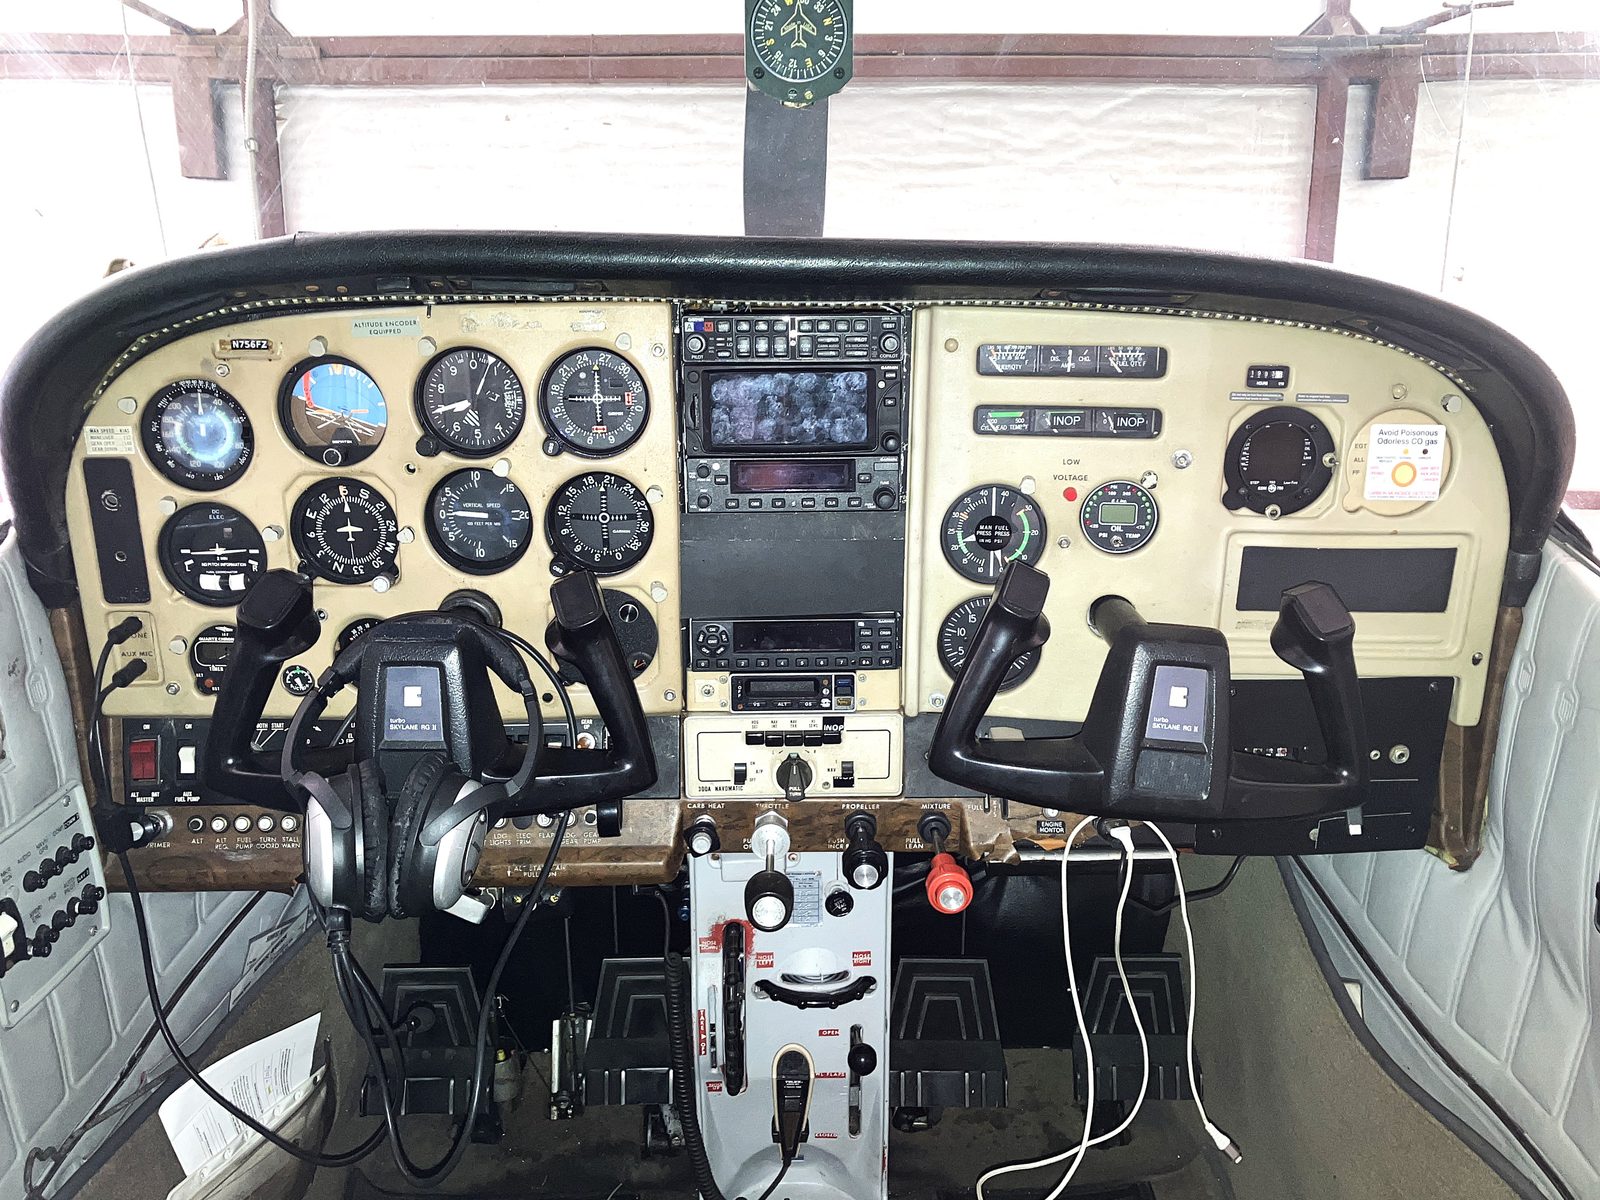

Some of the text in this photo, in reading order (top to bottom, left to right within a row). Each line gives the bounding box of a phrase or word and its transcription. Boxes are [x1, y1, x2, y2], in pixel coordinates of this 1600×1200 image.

[771, 5, 781, 16] 24
[814, 4, 824, 13] 33
[765, 20, 773, 31] 21
[823, 17, 832, 26] N
[766, 38, 774, 46] S
[789, 59, 797, 68] 12
[805, 57, 812, 68] E
[232, 339, 268, 350] N756FZ
[576, 354, 588, 364] 24
[599, 353, 611, 363] 27
[469, 360, 477, 369] 0
[619, 363, 630, 374] 30
[450, 366, 457, 376] 9
[559, 364, 570, 377] 21
[438, 384, 445, 393] 8
[504, 380, 511, 390] 2
[551, 384, 560, 395] 18
[632, 381, 642, 393] 33
[506, 409, 513, 418] 3
[552, 407, 561, 418] 15
[1053, 416, 1081, 426] INOP
[1117, 417, 1144, 427] INOP
[453, 422, 460, 431] 6
[495, 422, 503, 431] 4
[565, 425, 577, 437] 12
[475, 429, 481, 438] 5
[471, 471, 480, 480] 10
[583, 476, 594, 485] 18
[604, 475, 614, 484] 21
[445, 487, 451, 496] 5
[506, 484, 514, 492] 15
[566, 487, 577, 498] 15
[623, 483, 635, 495] 24
[319, 493, 330, 504] 12
[359, 489, 370, 499] S
[376, 501, 386, 511] 21
[558, 505, 567, 516] 12
[637, 500, 648, 511] 27
[306, 508, 317, 519] E
[440, 510, 445, 518] 0
[520, 511, 529, 519] 20
[386, 520, 396, 532] 24
[640, 521, 649, 532] 30
[449, 532, 455, 541] 5
[385, 542, 396, 553] W
[630, 539, 641, 550] 33
[317, 550, 325, 558] 3
[476, 549, 485, 557] 10
[594, 553, 601, 561] 3
[333, 561, 344, 573] N
[372, 557, 384, 568] 30
[353, 566, 364, 574] 33
[969, 614, 977, 623] 15
[957, 628, 966, 636] 10
[958, 647, 964, 655] 5
[1152, 723, 1180, 731] SKYLANE
